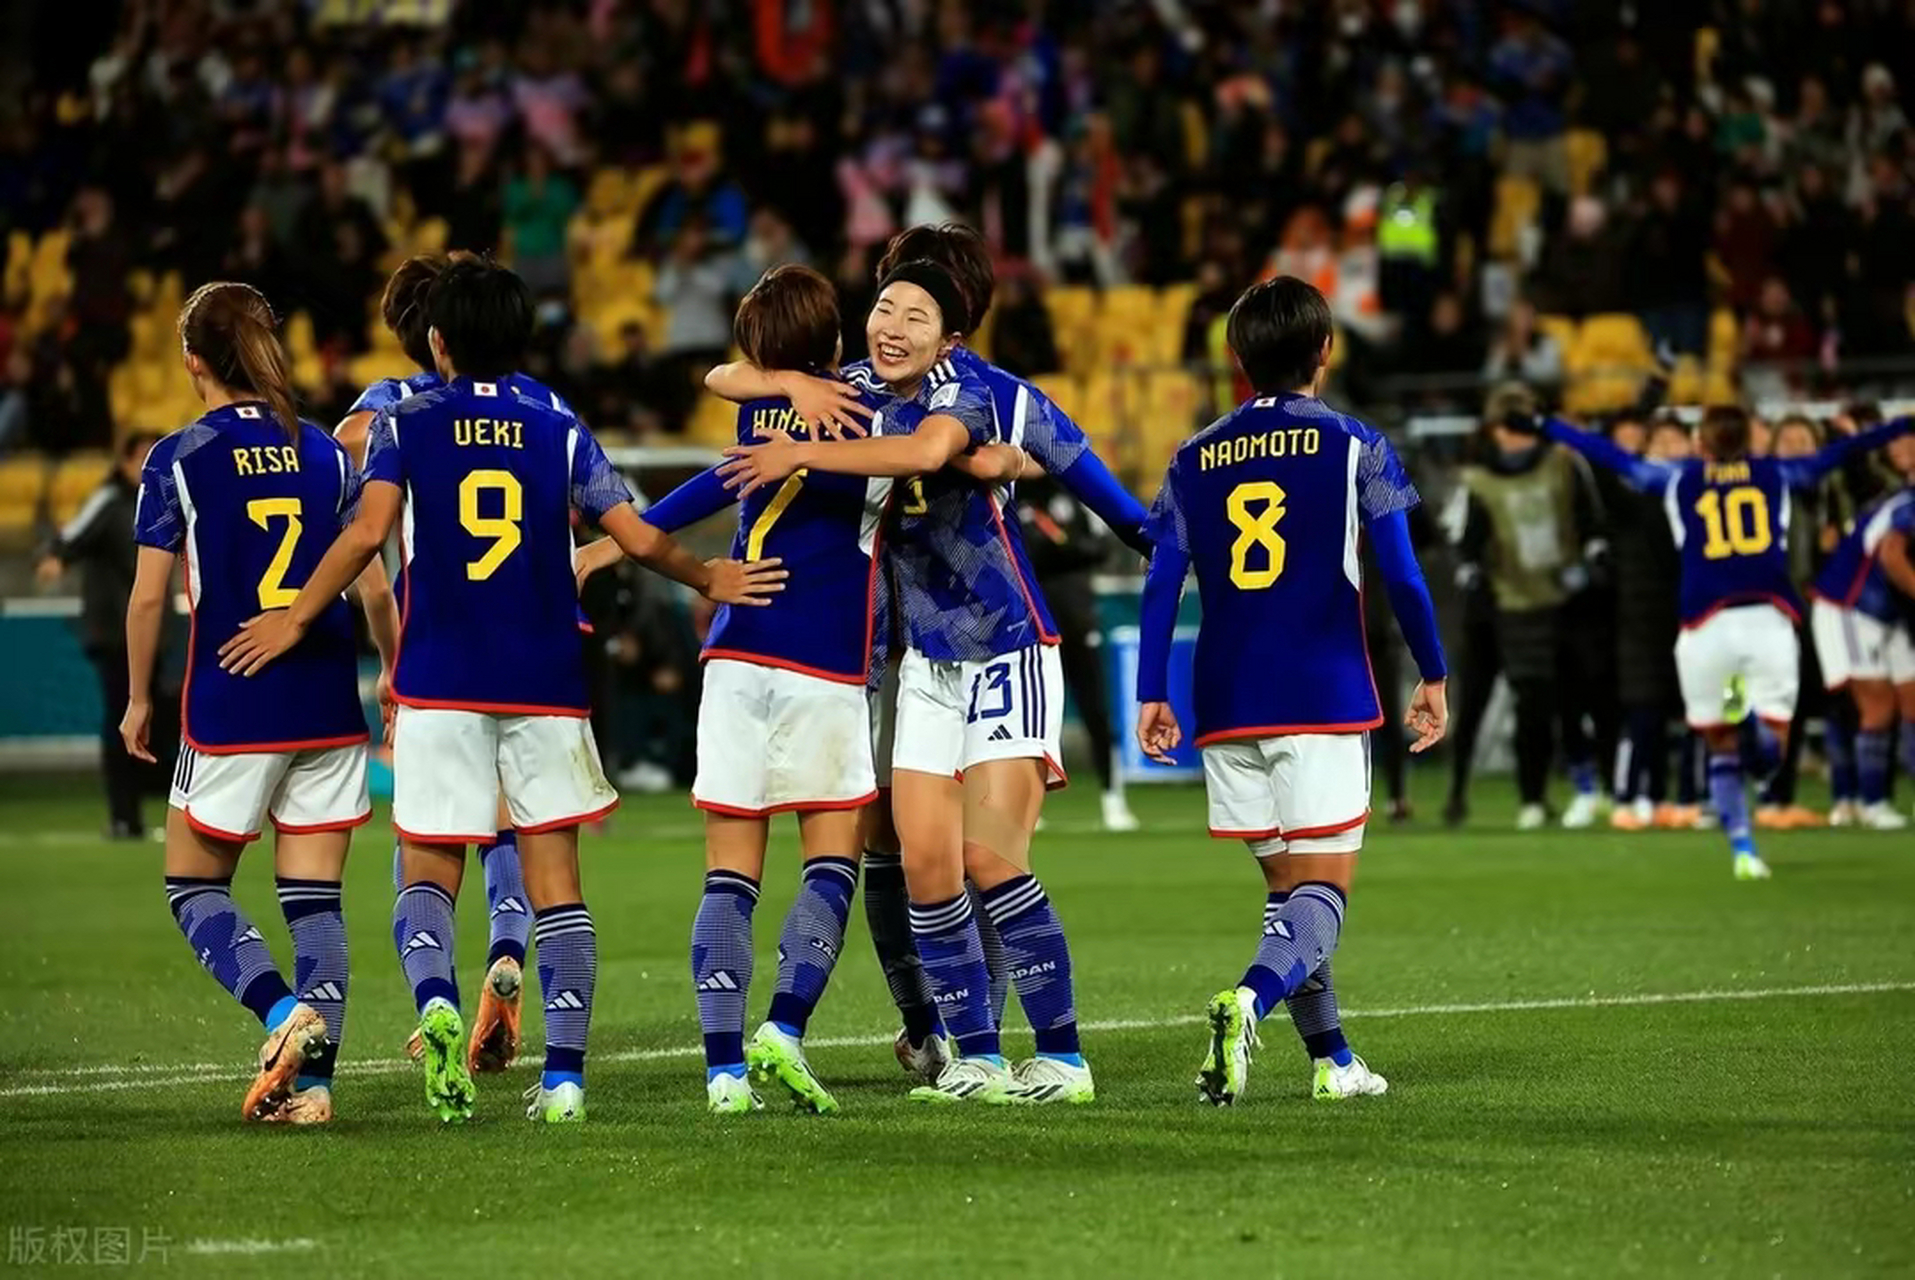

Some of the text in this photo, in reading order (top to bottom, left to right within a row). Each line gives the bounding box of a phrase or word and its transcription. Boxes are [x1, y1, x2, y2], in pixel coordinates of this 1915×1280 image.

[455, 418, 524, 449] UEKI
[752, 407, 842, 437] HINA
[1200, 428, 1320, 471] NAOMOTO
[233, 446, 300, 476] RISA
[247, 498, 303, 610] 2
[459, 469, 523, 581] 9
[1226, 481, 1287, 590] 8
[1694, 486, 1773, 560] 10
[966, 662, 1014, 724] 13
